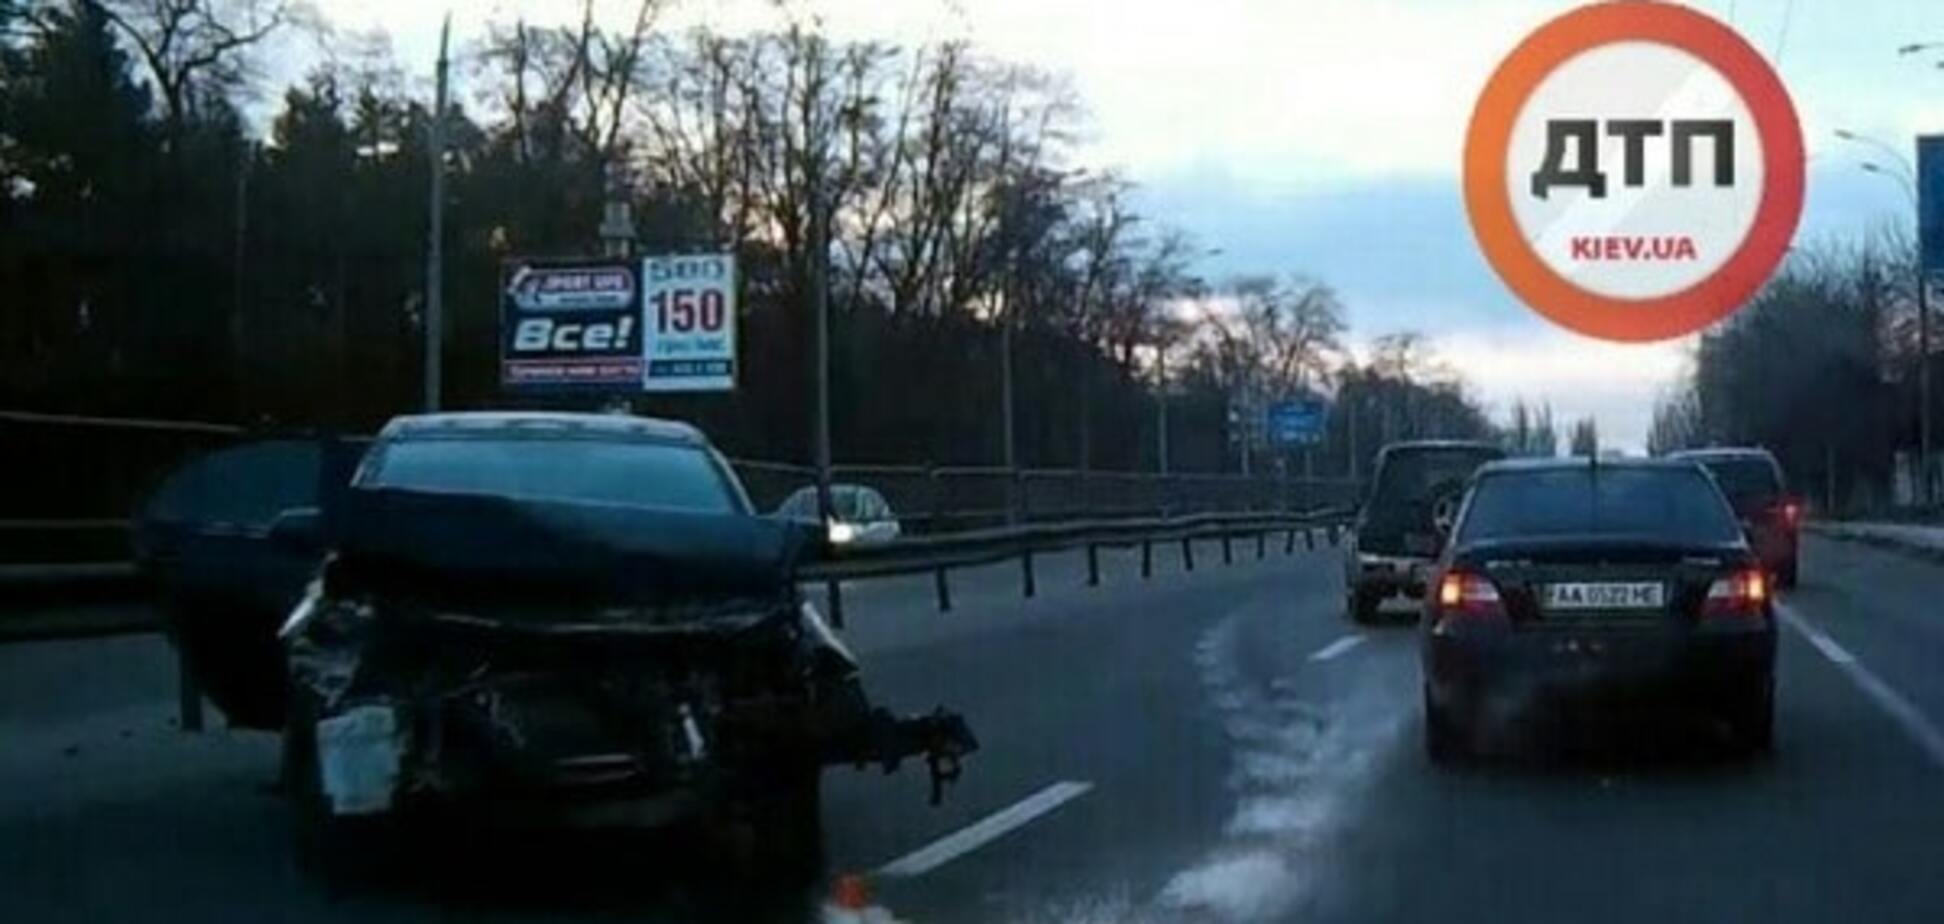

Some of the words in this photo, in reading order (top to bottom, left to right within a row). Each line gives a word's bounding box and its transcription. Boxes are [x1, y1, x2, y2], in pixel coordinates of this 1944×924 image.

[650, 287, 725, 335] 150
[514, 316, 634, 351] Все!
[1558, 586, 1583, 604] AA
